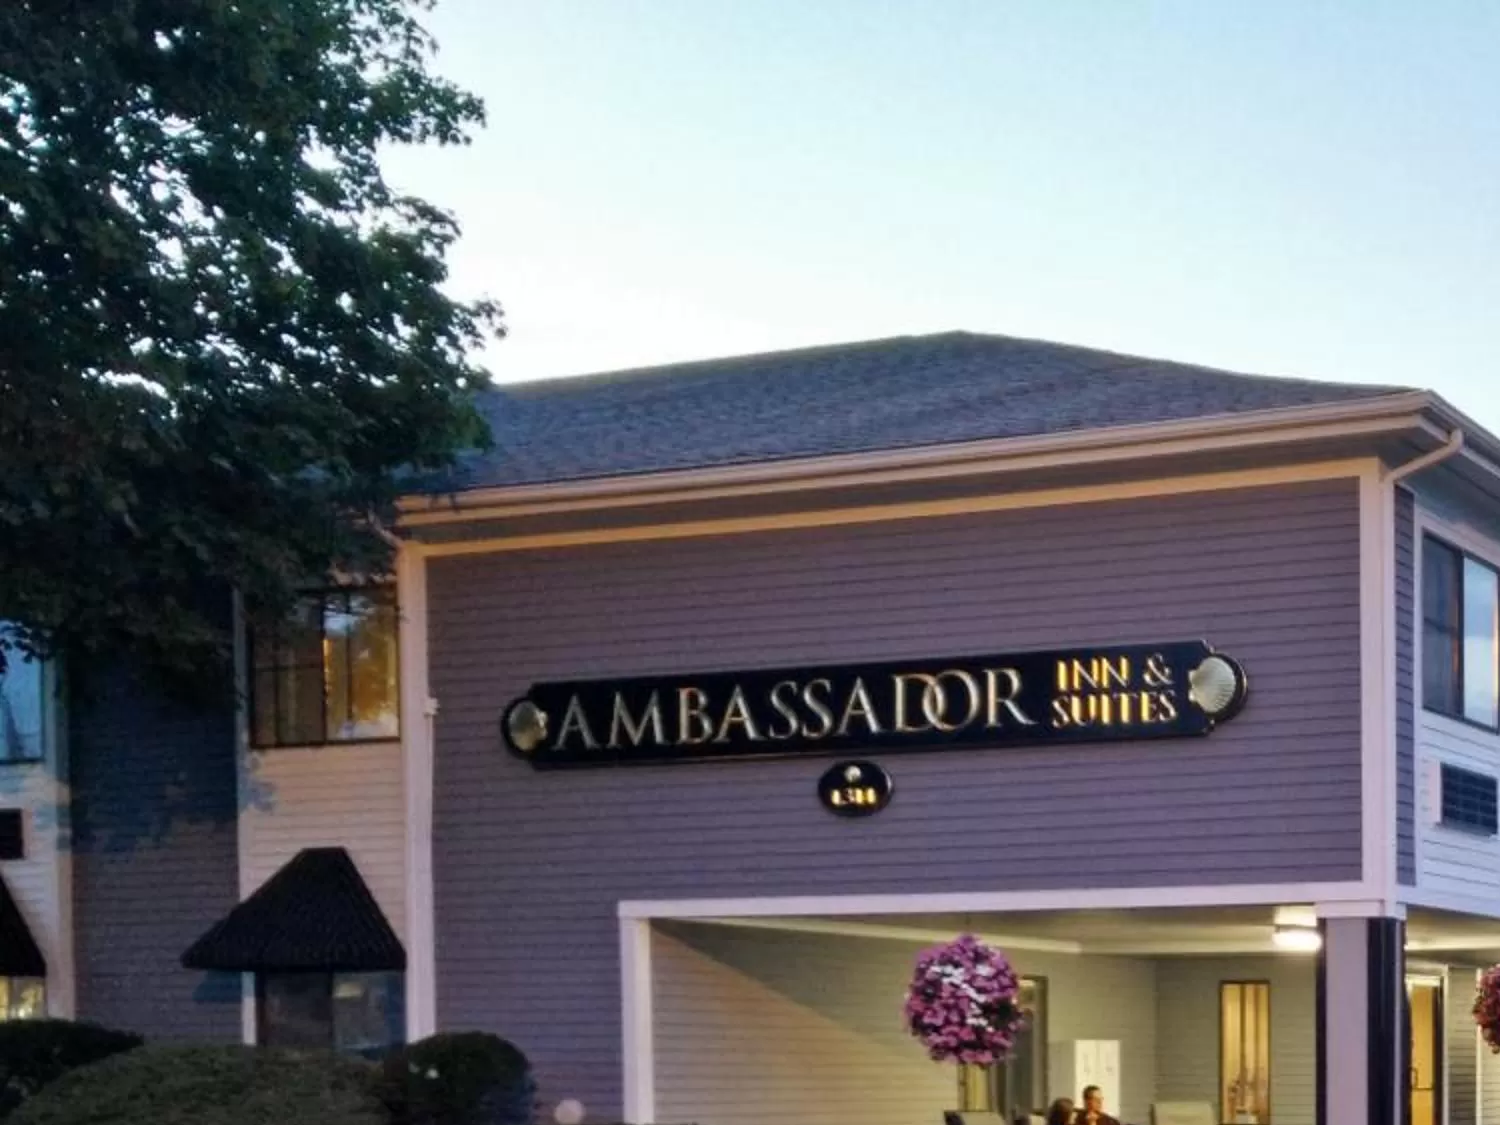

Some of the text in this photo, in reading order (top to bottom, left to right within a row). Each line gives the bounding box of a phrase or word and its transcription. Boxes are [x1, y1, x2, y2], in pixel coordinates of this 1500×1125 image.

[1057, 652, 1174, 691] INN &
[551, 666, 1038, 750] AMBASSADOR
[1052, 689, 1177, 728] SUITES
